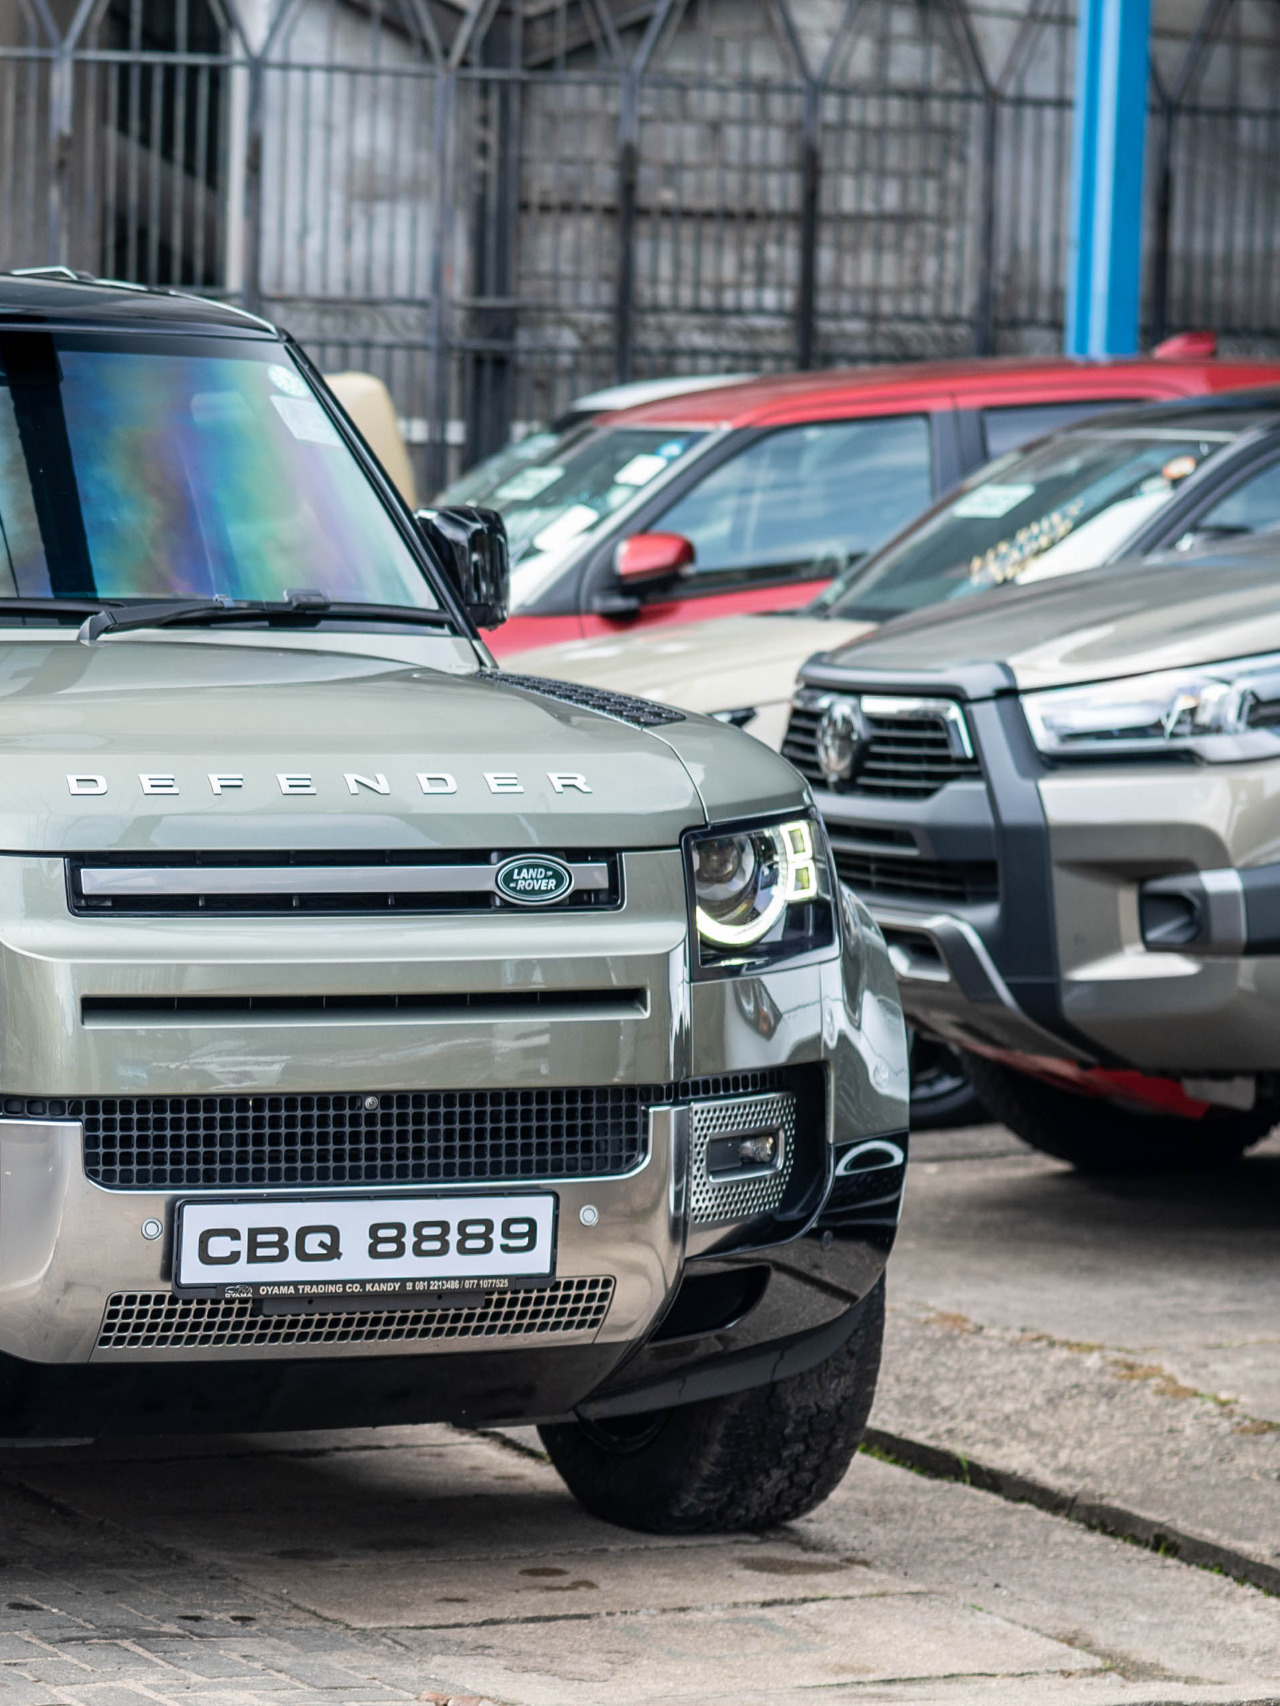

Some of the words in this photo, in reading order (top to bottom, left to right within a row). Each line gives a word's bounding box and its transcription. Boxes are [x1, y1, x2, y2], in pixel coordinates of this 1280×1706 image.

[65, 771, 593, 795] DEFENDER
[513, 867, 546, 880] LAND
[516, 878, 557, 891] ROVER
[197, 1224, 343, 1266] CBQ
[368, 1217, 538, 1260] 8889
[259, 1285, 295, 1295] OYAMA
[298, 1283, 343, 1294] TRADING
[345, 1283, 363, 1293] CO.
[366, 1282, 401, 1293] KANDY
[464, 1278, 478, 1289] 077
